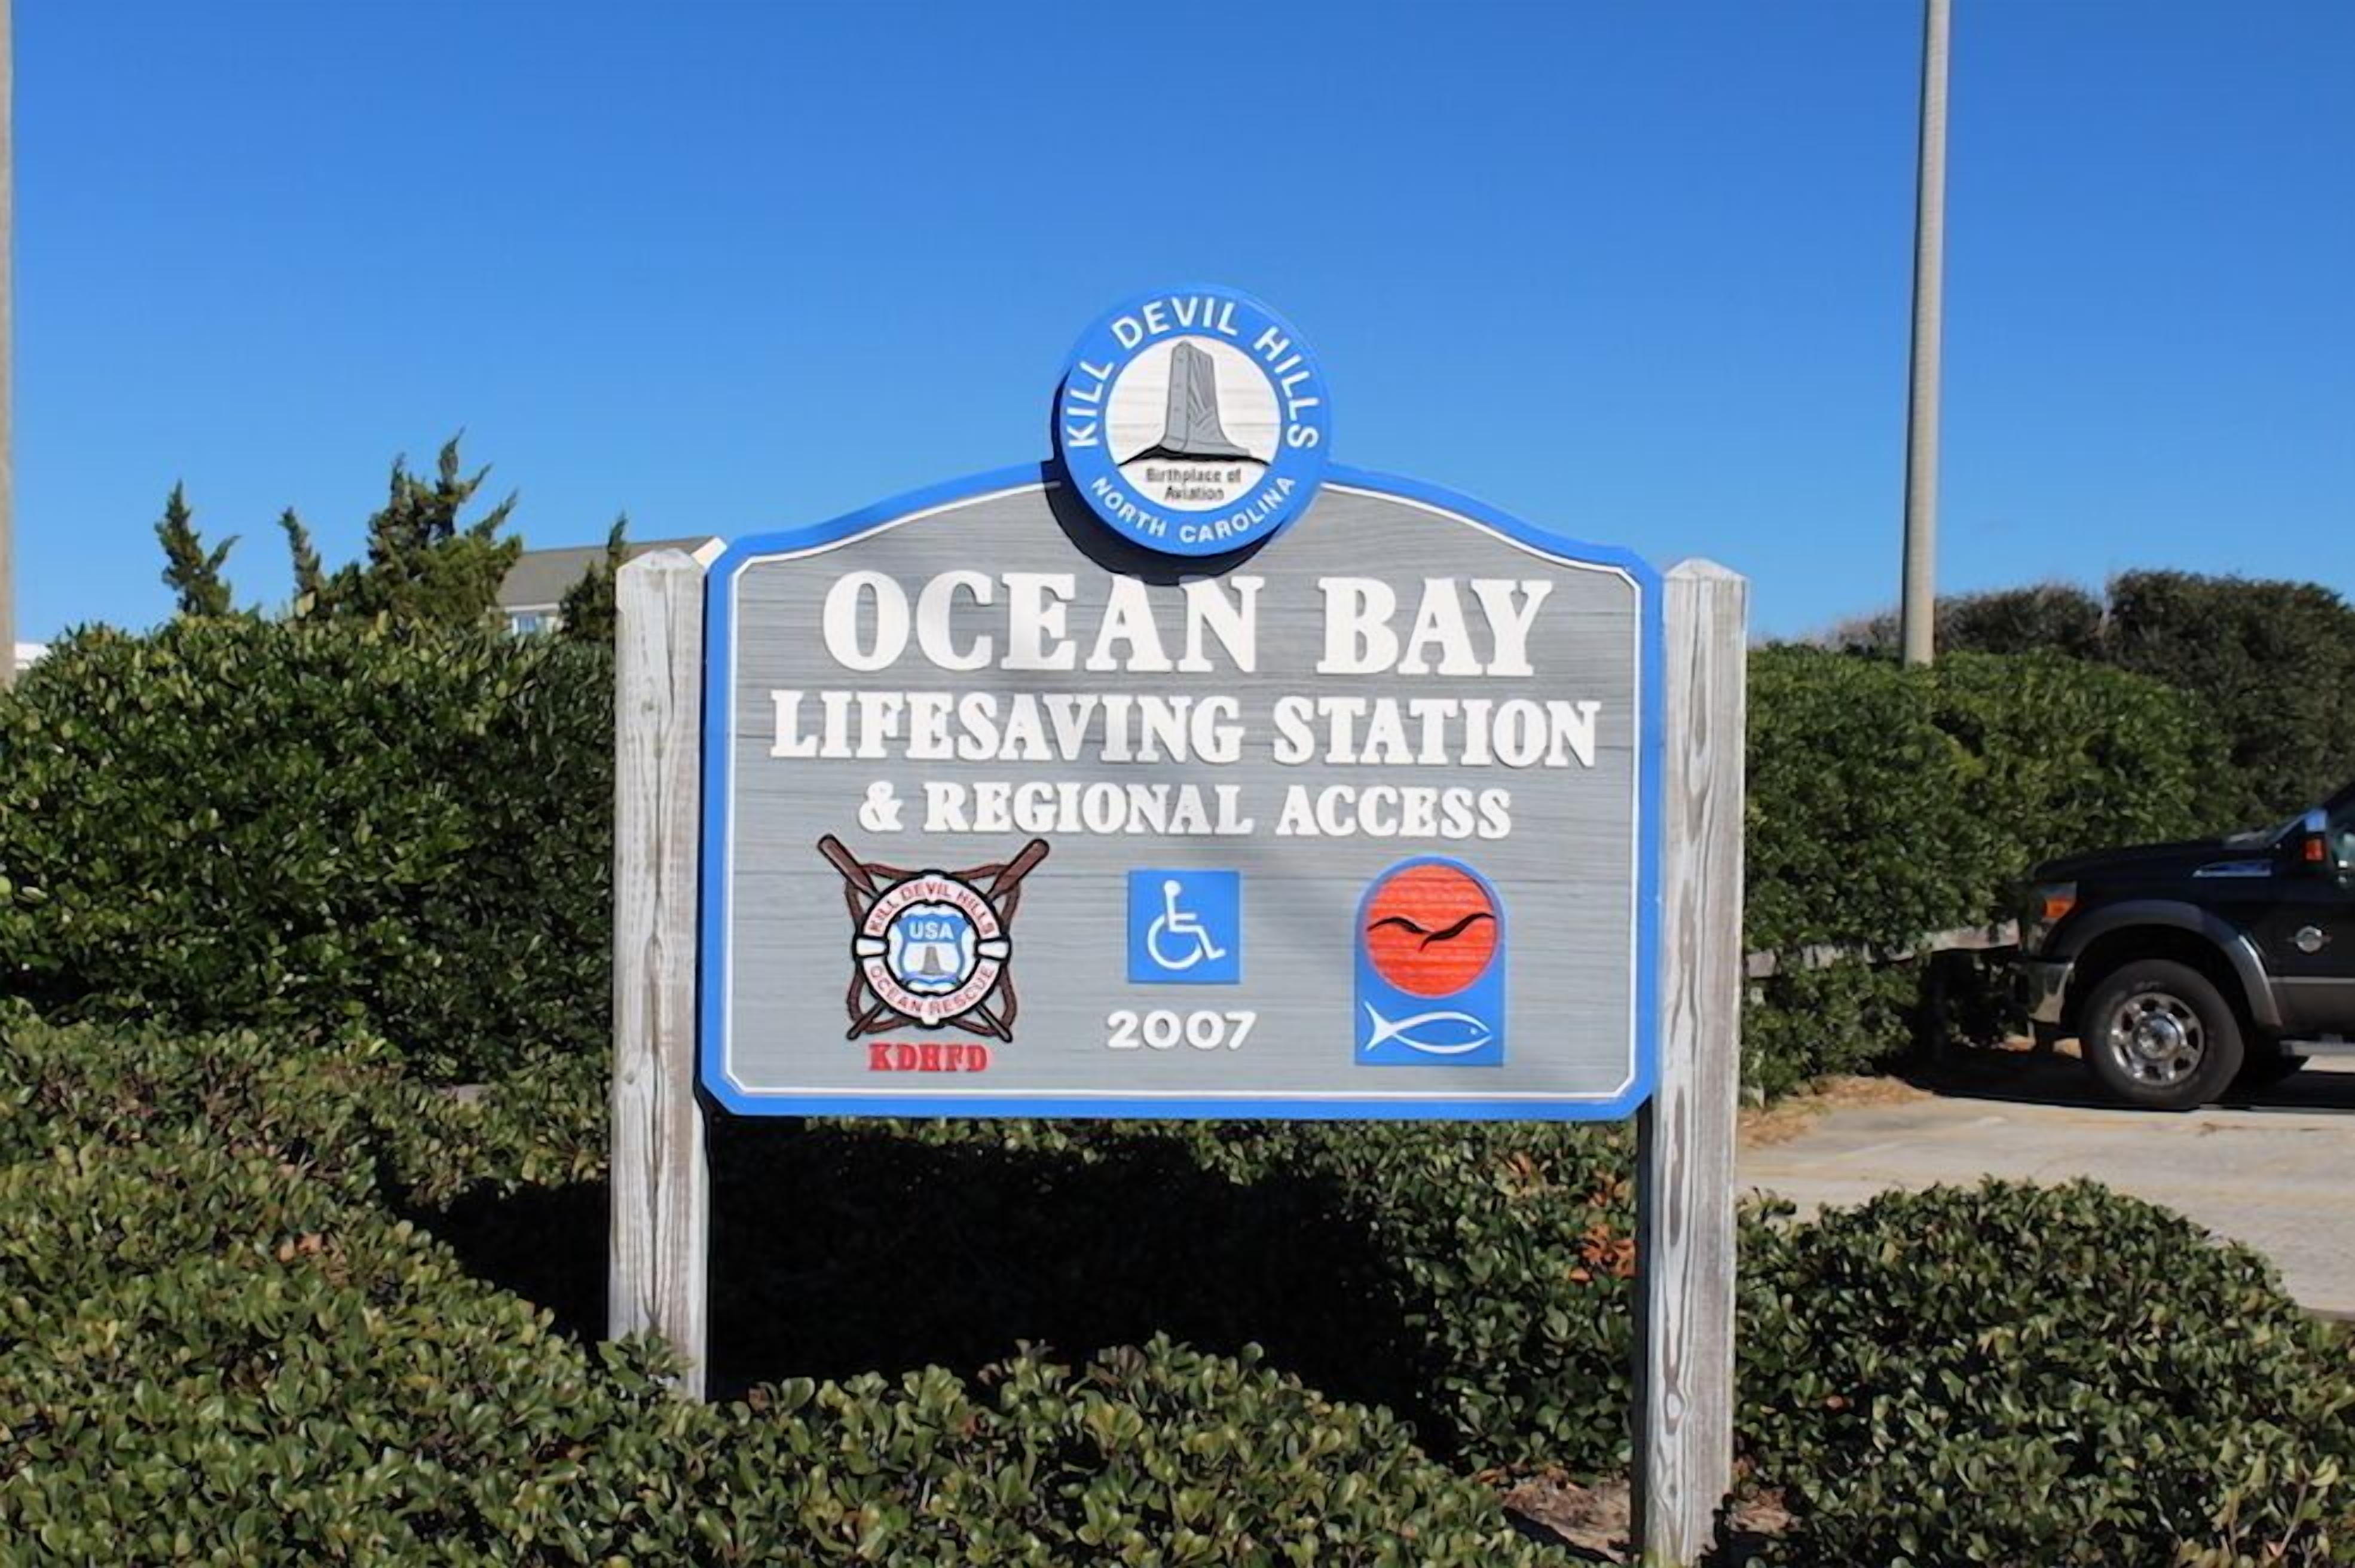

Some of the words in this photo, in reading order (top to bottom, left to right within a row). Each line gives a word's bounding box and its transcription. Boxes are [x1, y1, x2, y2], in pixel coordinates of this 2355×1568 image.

[1067, 362, 1114, 448] KILL
[1112, 297, 1238, 349] DEVIL
[1253, 326, 1319, 449] HILLS
[1091, 477, 1167, 538] NORTH
[1179, 477, 1295, 543] CAROLINA
[822, 571, 1265, 673] OCEAN
[1317, 576, 1554, 677] BAY
[770, 689, 1245, 765] LIFESAVING
[1273, 697, 1602, 769] STATION
[859, 780, 904, 833] &
[923, 782, 1254, 837] REGIONAL
[1276, 784, 1512, 838] ACCESS
[908, 921, 955, 941] USA
[868, 1045, 989, 1072] KDHFD
[1106, 1011, 1256, 1050] 2007
